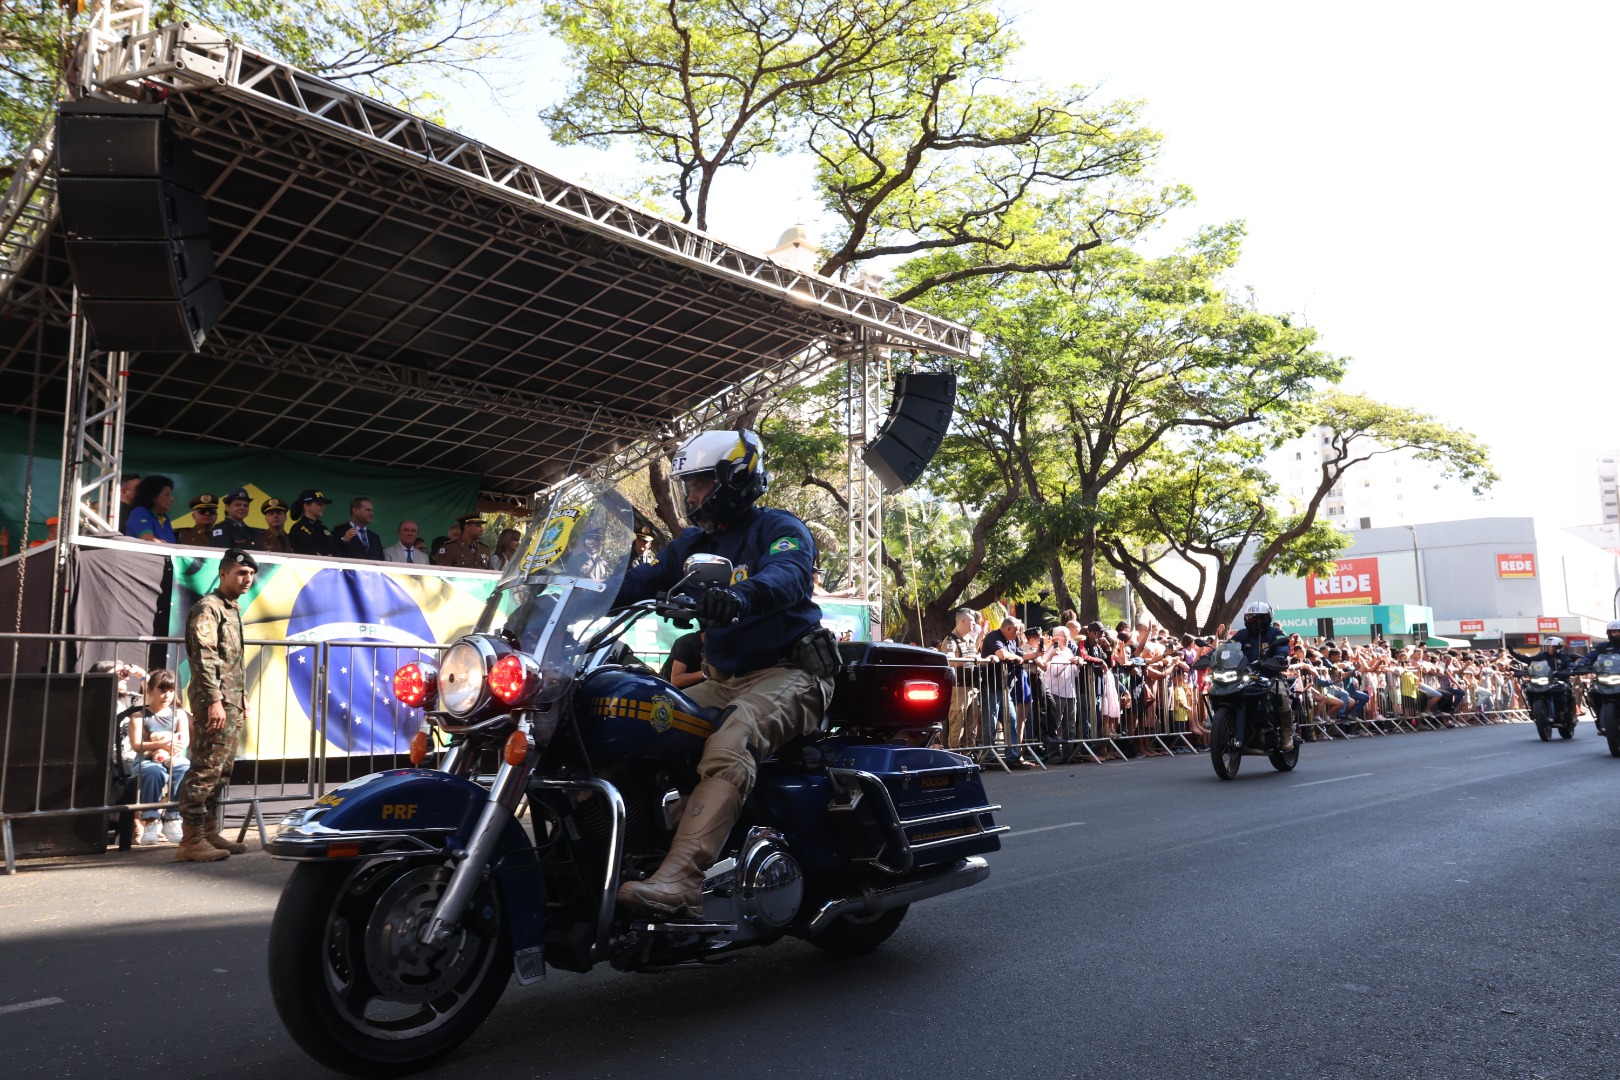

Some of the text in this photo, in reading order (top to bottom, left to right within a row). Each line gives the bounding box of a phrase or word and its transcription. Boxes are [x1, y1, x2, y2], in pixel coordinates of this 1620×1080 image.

[672, 457, 687, 472] RF
[1332, 563, 1353, 571] OJAS
[1501, 560, 1532, 571] REDE
[1314, 574, 1371, 595] REDE
[382, 804, 418, 819] PRF
